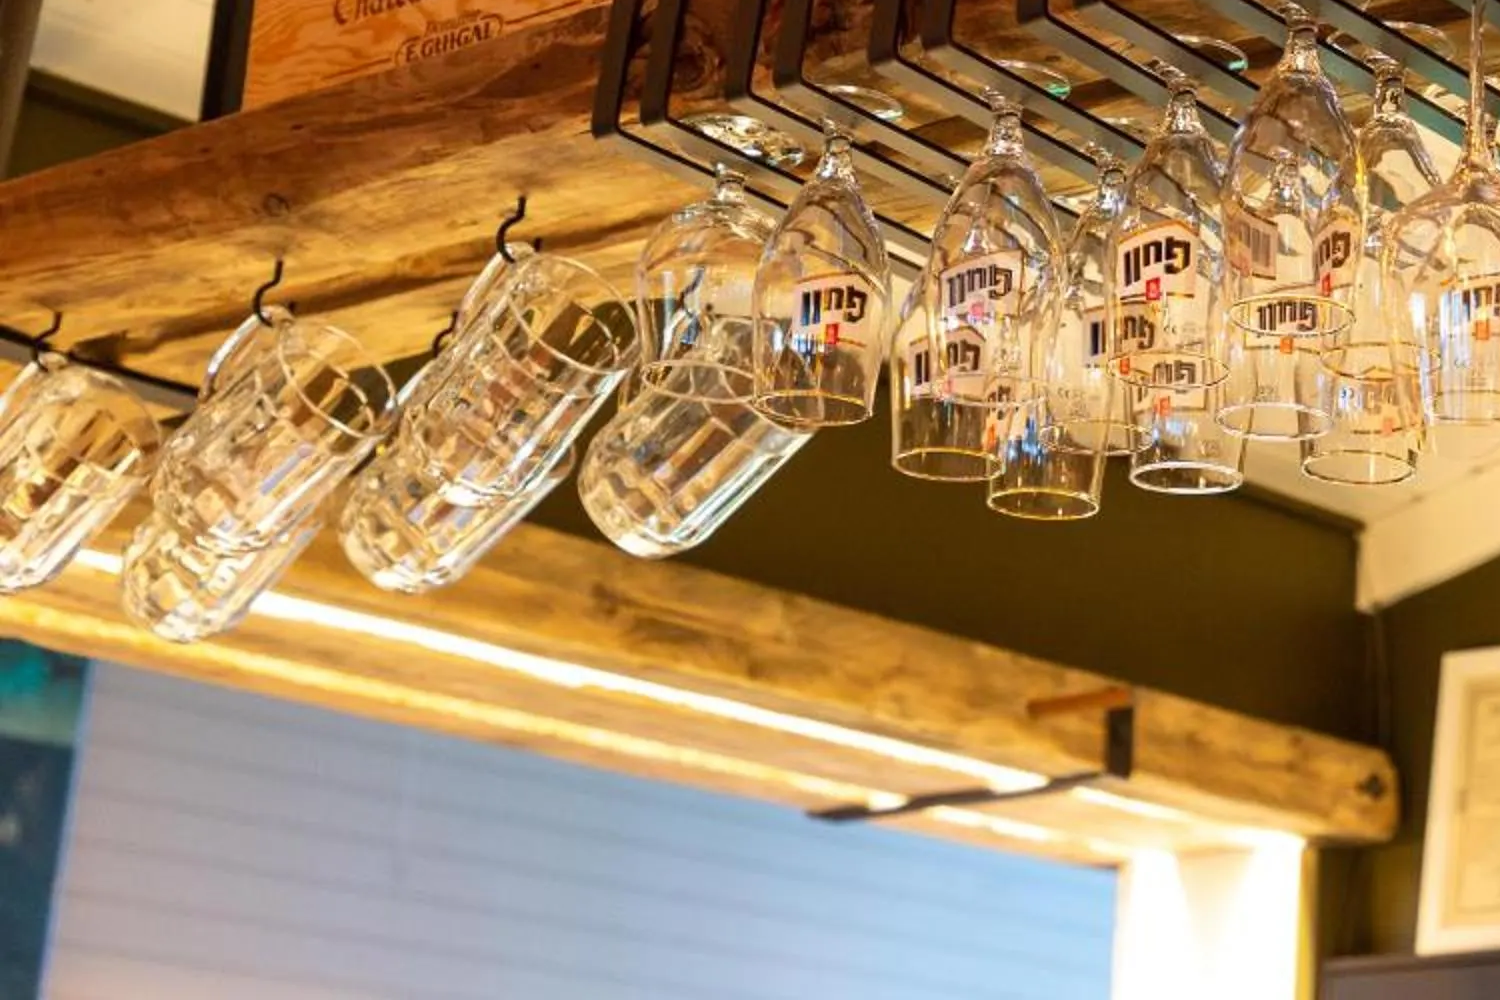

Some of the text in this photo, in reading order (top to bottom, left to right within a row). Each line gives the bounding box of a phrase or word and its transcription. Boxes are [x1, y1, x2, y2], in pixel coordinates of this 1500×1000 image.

[1123, 236, 1191, 288] Gull
[801, 285, 868, 327] Gull
[947, 264, 1013, 308] Gull
[1256, 301, 1318, 331] Gull
